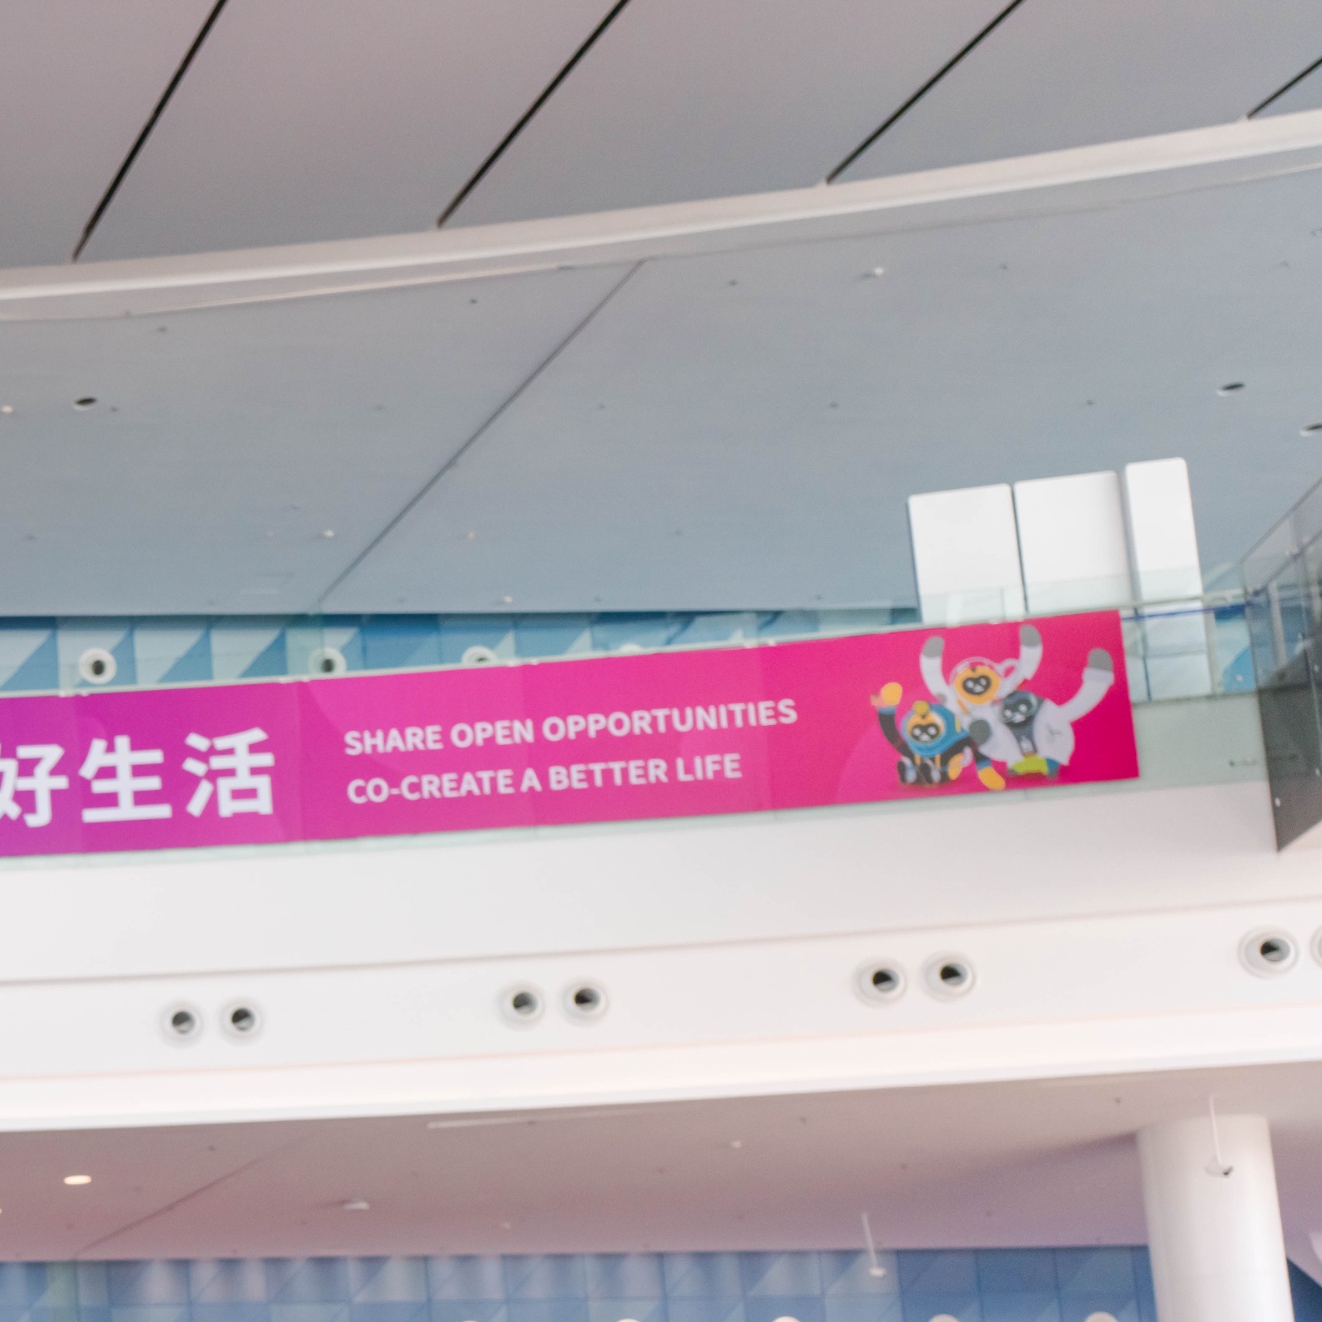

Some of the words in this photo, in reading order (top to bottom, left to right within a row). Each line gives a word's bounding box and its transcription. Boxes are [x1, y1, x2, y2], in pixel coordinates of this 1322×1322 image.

[343, 723, 445, 758] SHARE
[450, 717, 535, 750] OPEN
[541, 697, 799, 743] OPPORTUNITIES
[346, 766, 516, 806] CO-CREATE
[518, 764, 542, 795] A
[548, 756, 671, 793] BETTER
[675, 751, 744, 784] LIFE
